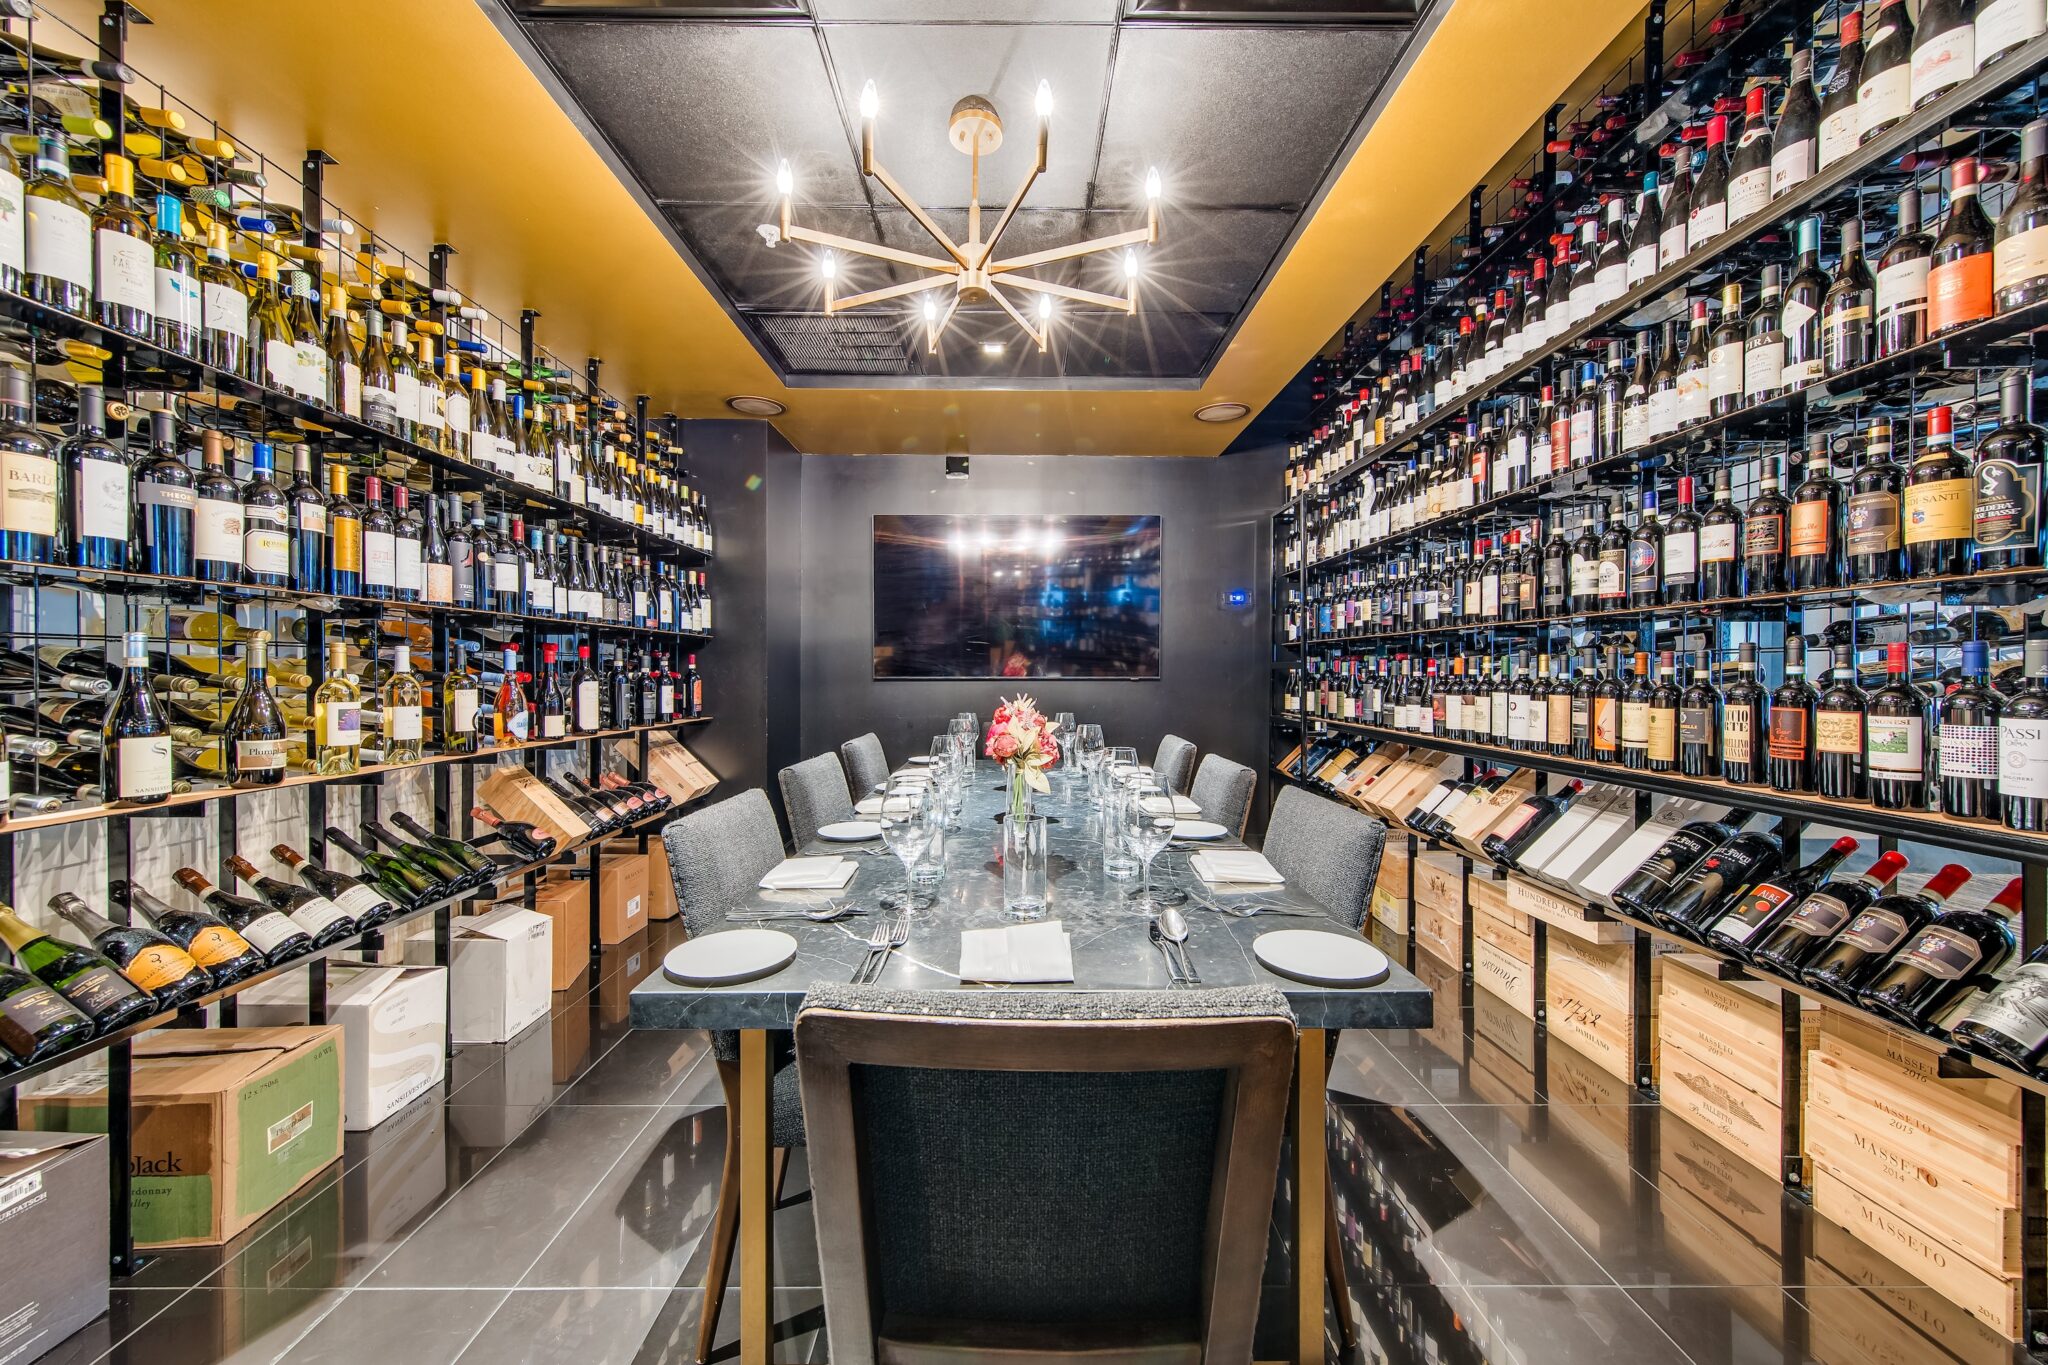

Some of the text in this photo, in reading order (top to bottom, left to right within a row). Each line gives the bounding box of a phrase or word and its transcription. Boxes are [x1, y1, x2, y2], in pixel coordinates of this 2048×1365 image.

[9, 471, 52, 488] BARL
[2000, 725, 2041, 740] PASSI
[1517, 886, 1558, 910] HUNDRED
[1757, 889, 1781, 904] ALBE
[1873, 1098, 1933, 1135] MASSETO
[1888, 1117, 1914, 1136] 2015
[1853, 1132, 1940, 1189] MASSETO
[1881, 1163, 1906, 1184] 2014
[1860, 1205, 1948, 1270] MASSETO
[1977, 1304, 2002, 1326] 2013
